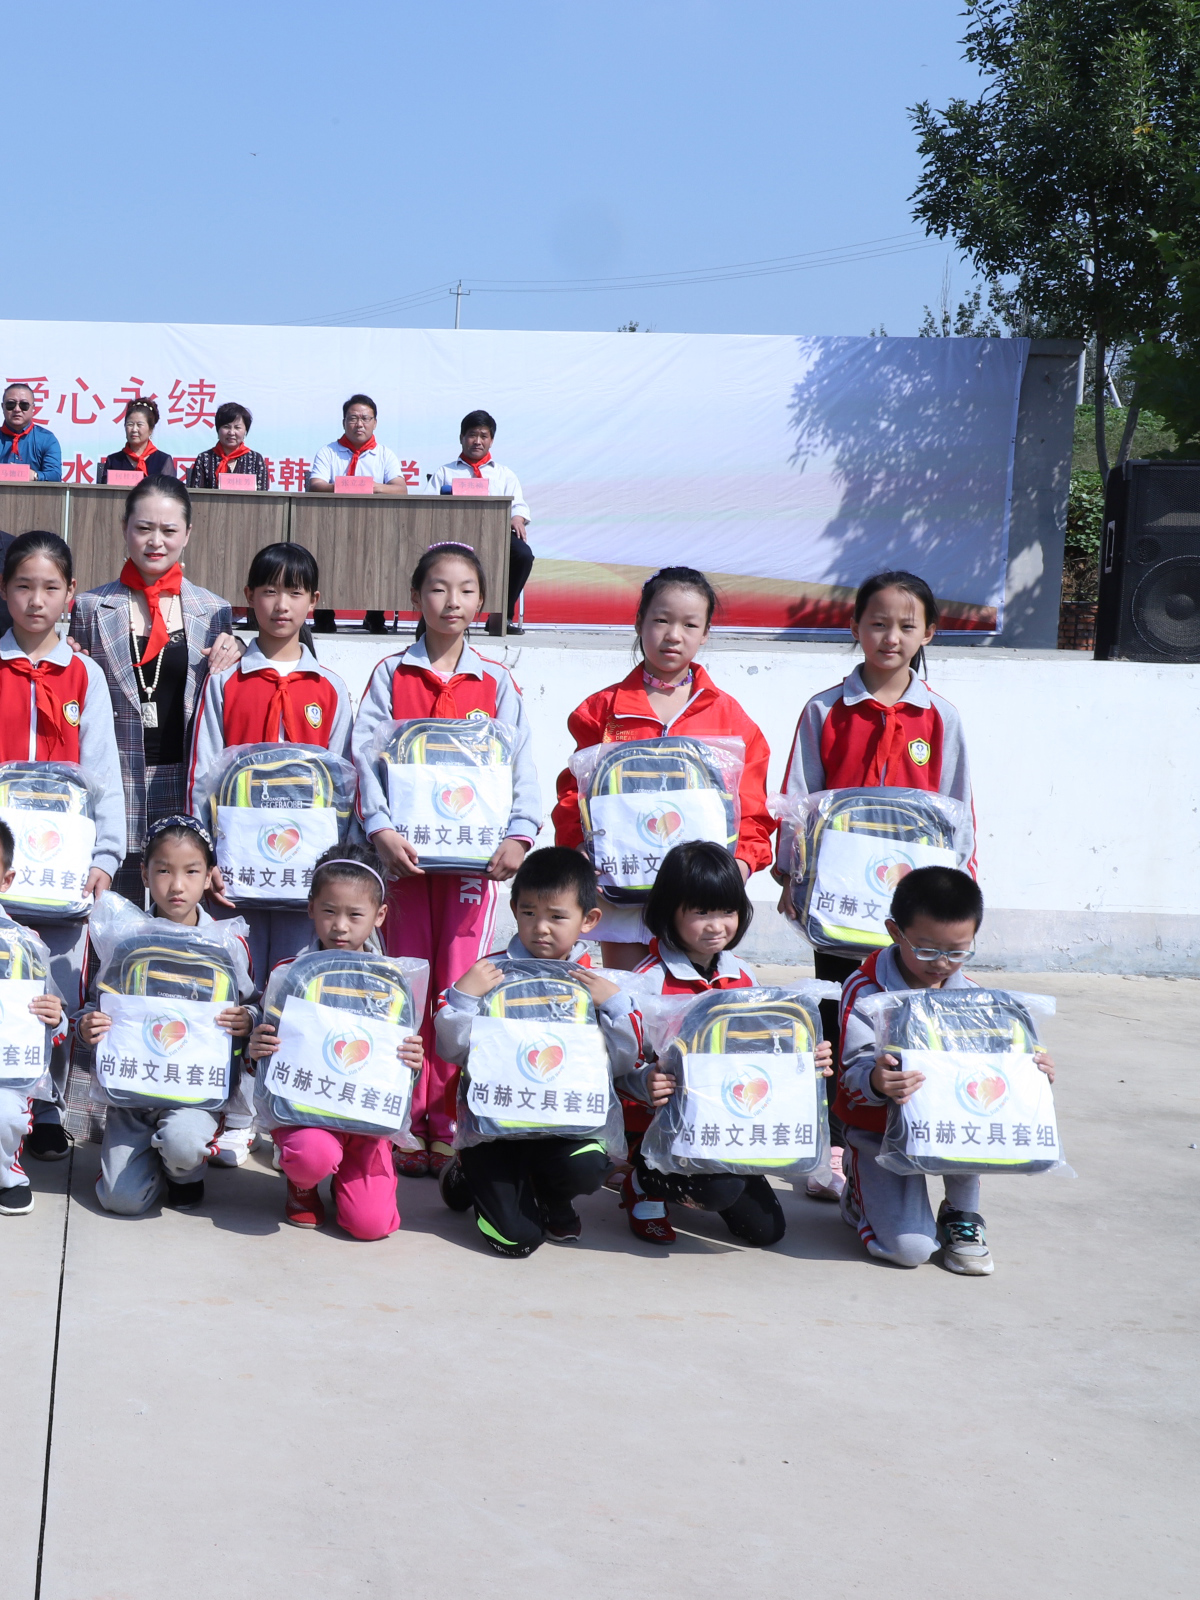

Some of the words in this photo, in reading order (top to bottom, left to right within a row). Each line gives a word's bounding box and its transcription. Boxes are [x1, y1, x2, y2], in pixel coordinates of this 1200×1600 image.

[220, 866, 313, 888] 尚赫文具套
[601, 853, 661, 876] 尚赫文
[817, 891, 884, 921] 尚赫文
[100, 1055, 227, 1088] 尚赫文具套组
[272, 1061, 403, 1117] 尚赫文具套组
[472, 1082, 606, 1114] 尚赫文具套组
[680, 1122, 814, 1147] 尚赫文具套组
[910, 1120, 1056, 1147] 尚赫文具套组
